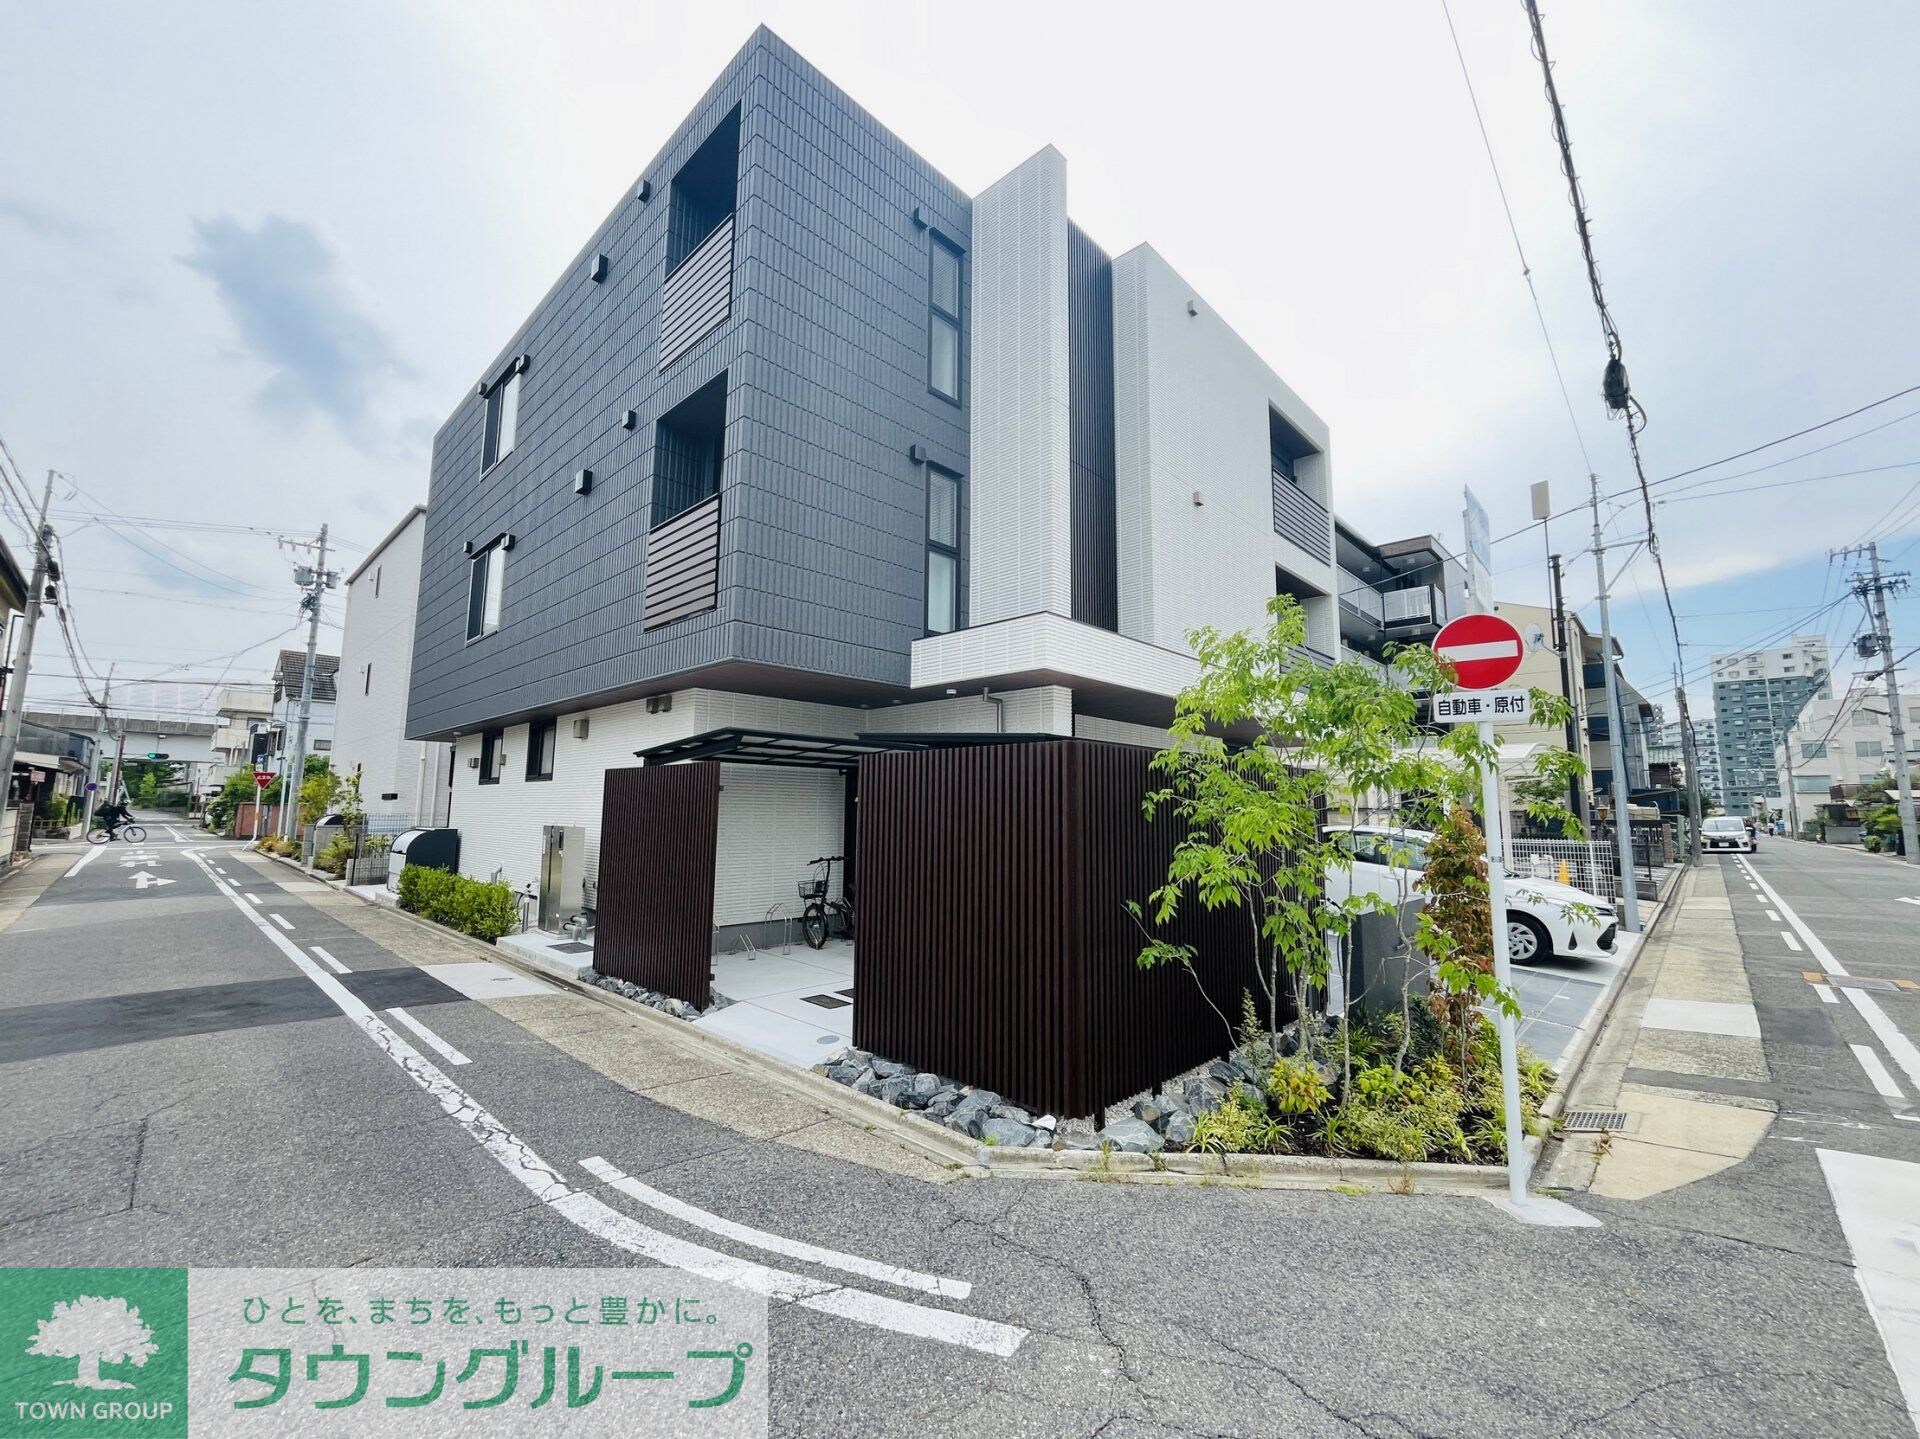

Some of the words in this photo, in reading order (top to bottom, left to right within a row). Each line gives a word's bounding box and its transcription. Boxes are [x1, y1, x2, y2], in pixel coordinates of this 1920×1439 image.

[1438, 695, 1525, 716] 自動車・原付
